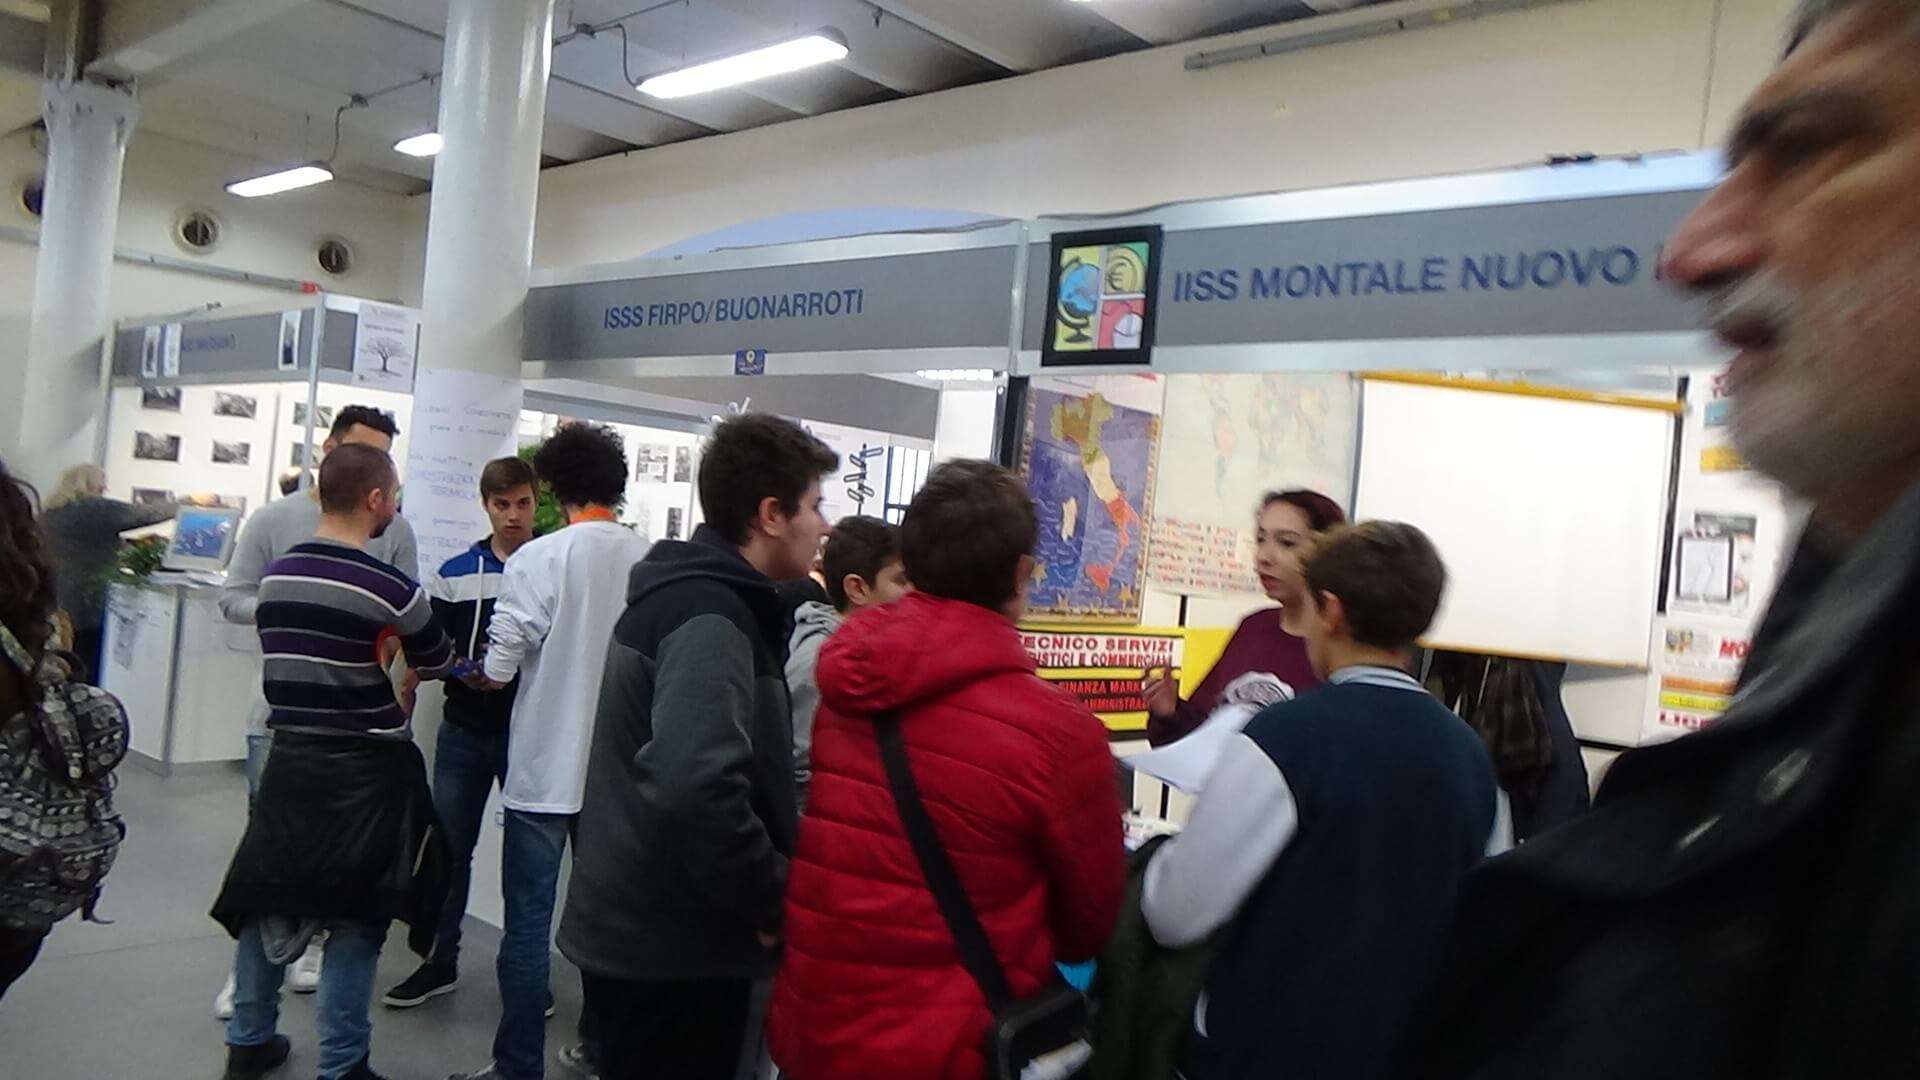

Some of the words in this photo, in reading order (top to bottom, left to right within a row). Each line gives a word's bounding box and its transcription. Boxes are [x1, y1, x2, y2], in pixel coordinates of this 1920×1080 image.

[1173, 268, 1240, 302] IISS
[1250, 255, 1448, 299] MONTALE
[1459, 244, 1642, 292] NUOVO
[603, 304, 644, 330] ISSS
[648, 288, 865, 327] FIRPO/BUONARROTI
[1104, 639, 1175, 652] SERVIZI
[1090, 653, 1173, 668] COMMERCIALI
